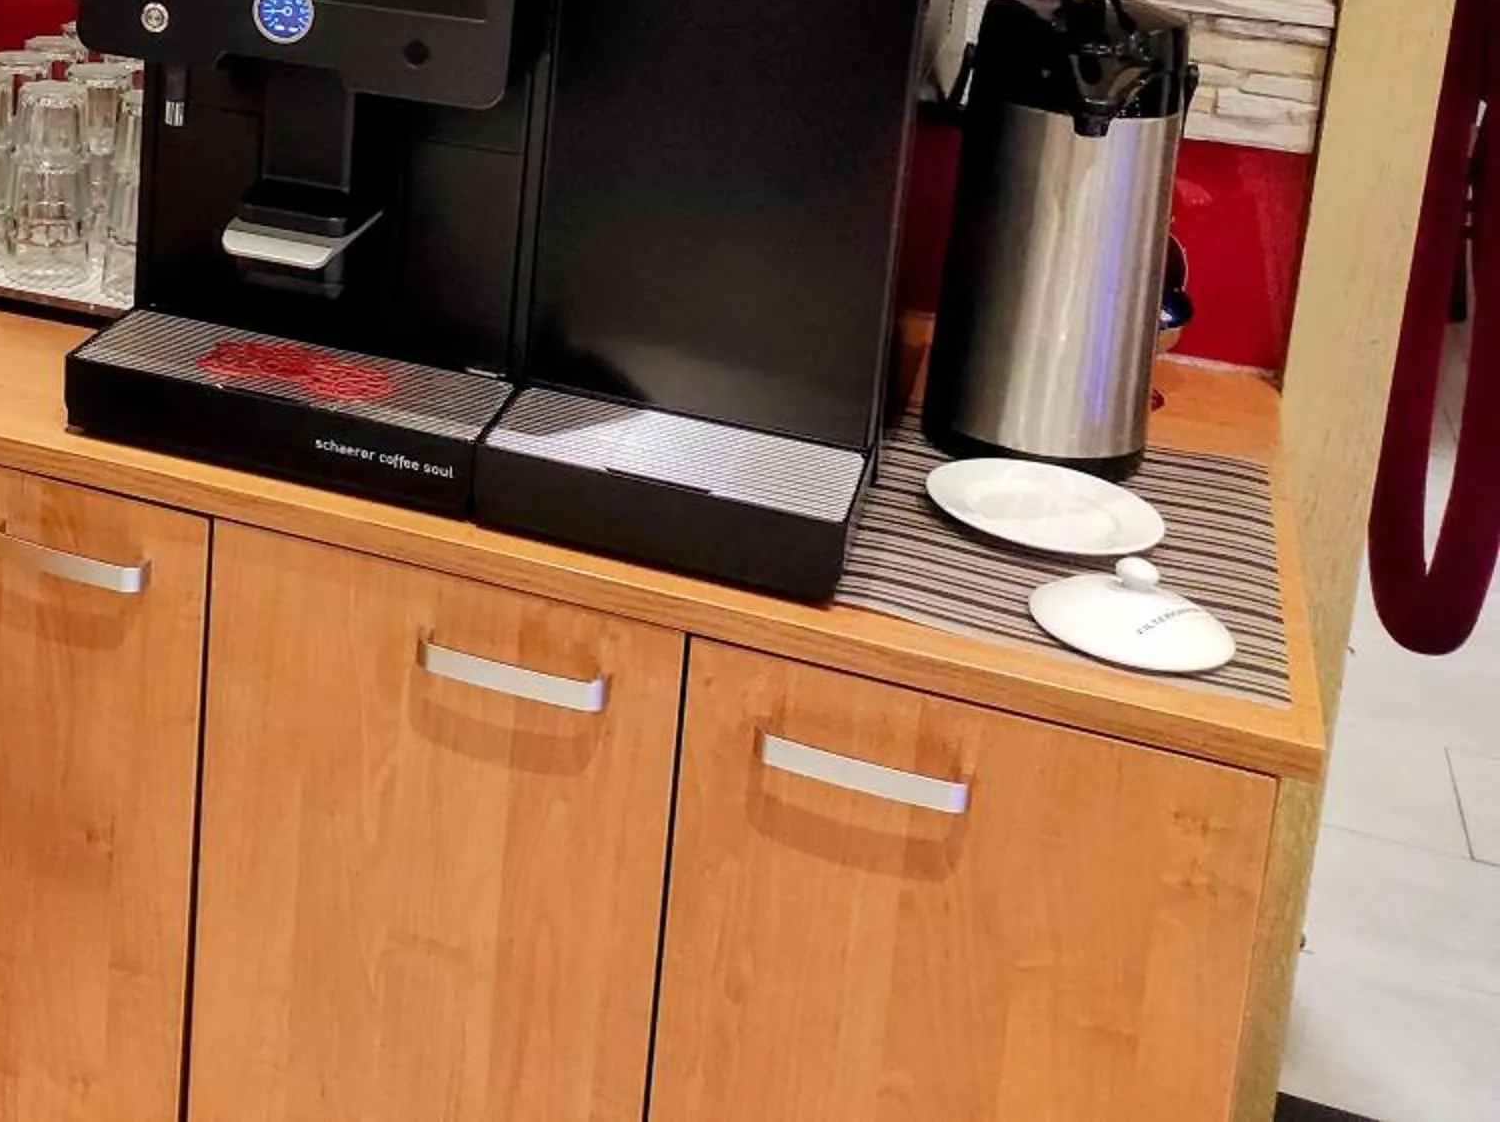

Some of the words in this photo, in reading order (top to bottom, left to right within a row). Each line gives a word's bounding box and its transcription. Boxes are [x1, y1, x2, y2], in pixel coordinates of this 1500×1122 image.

[315, 439, 376, 461] schaerer
[379, 453, 420, 471] coffee
[422, 463, 454, 478] soul
